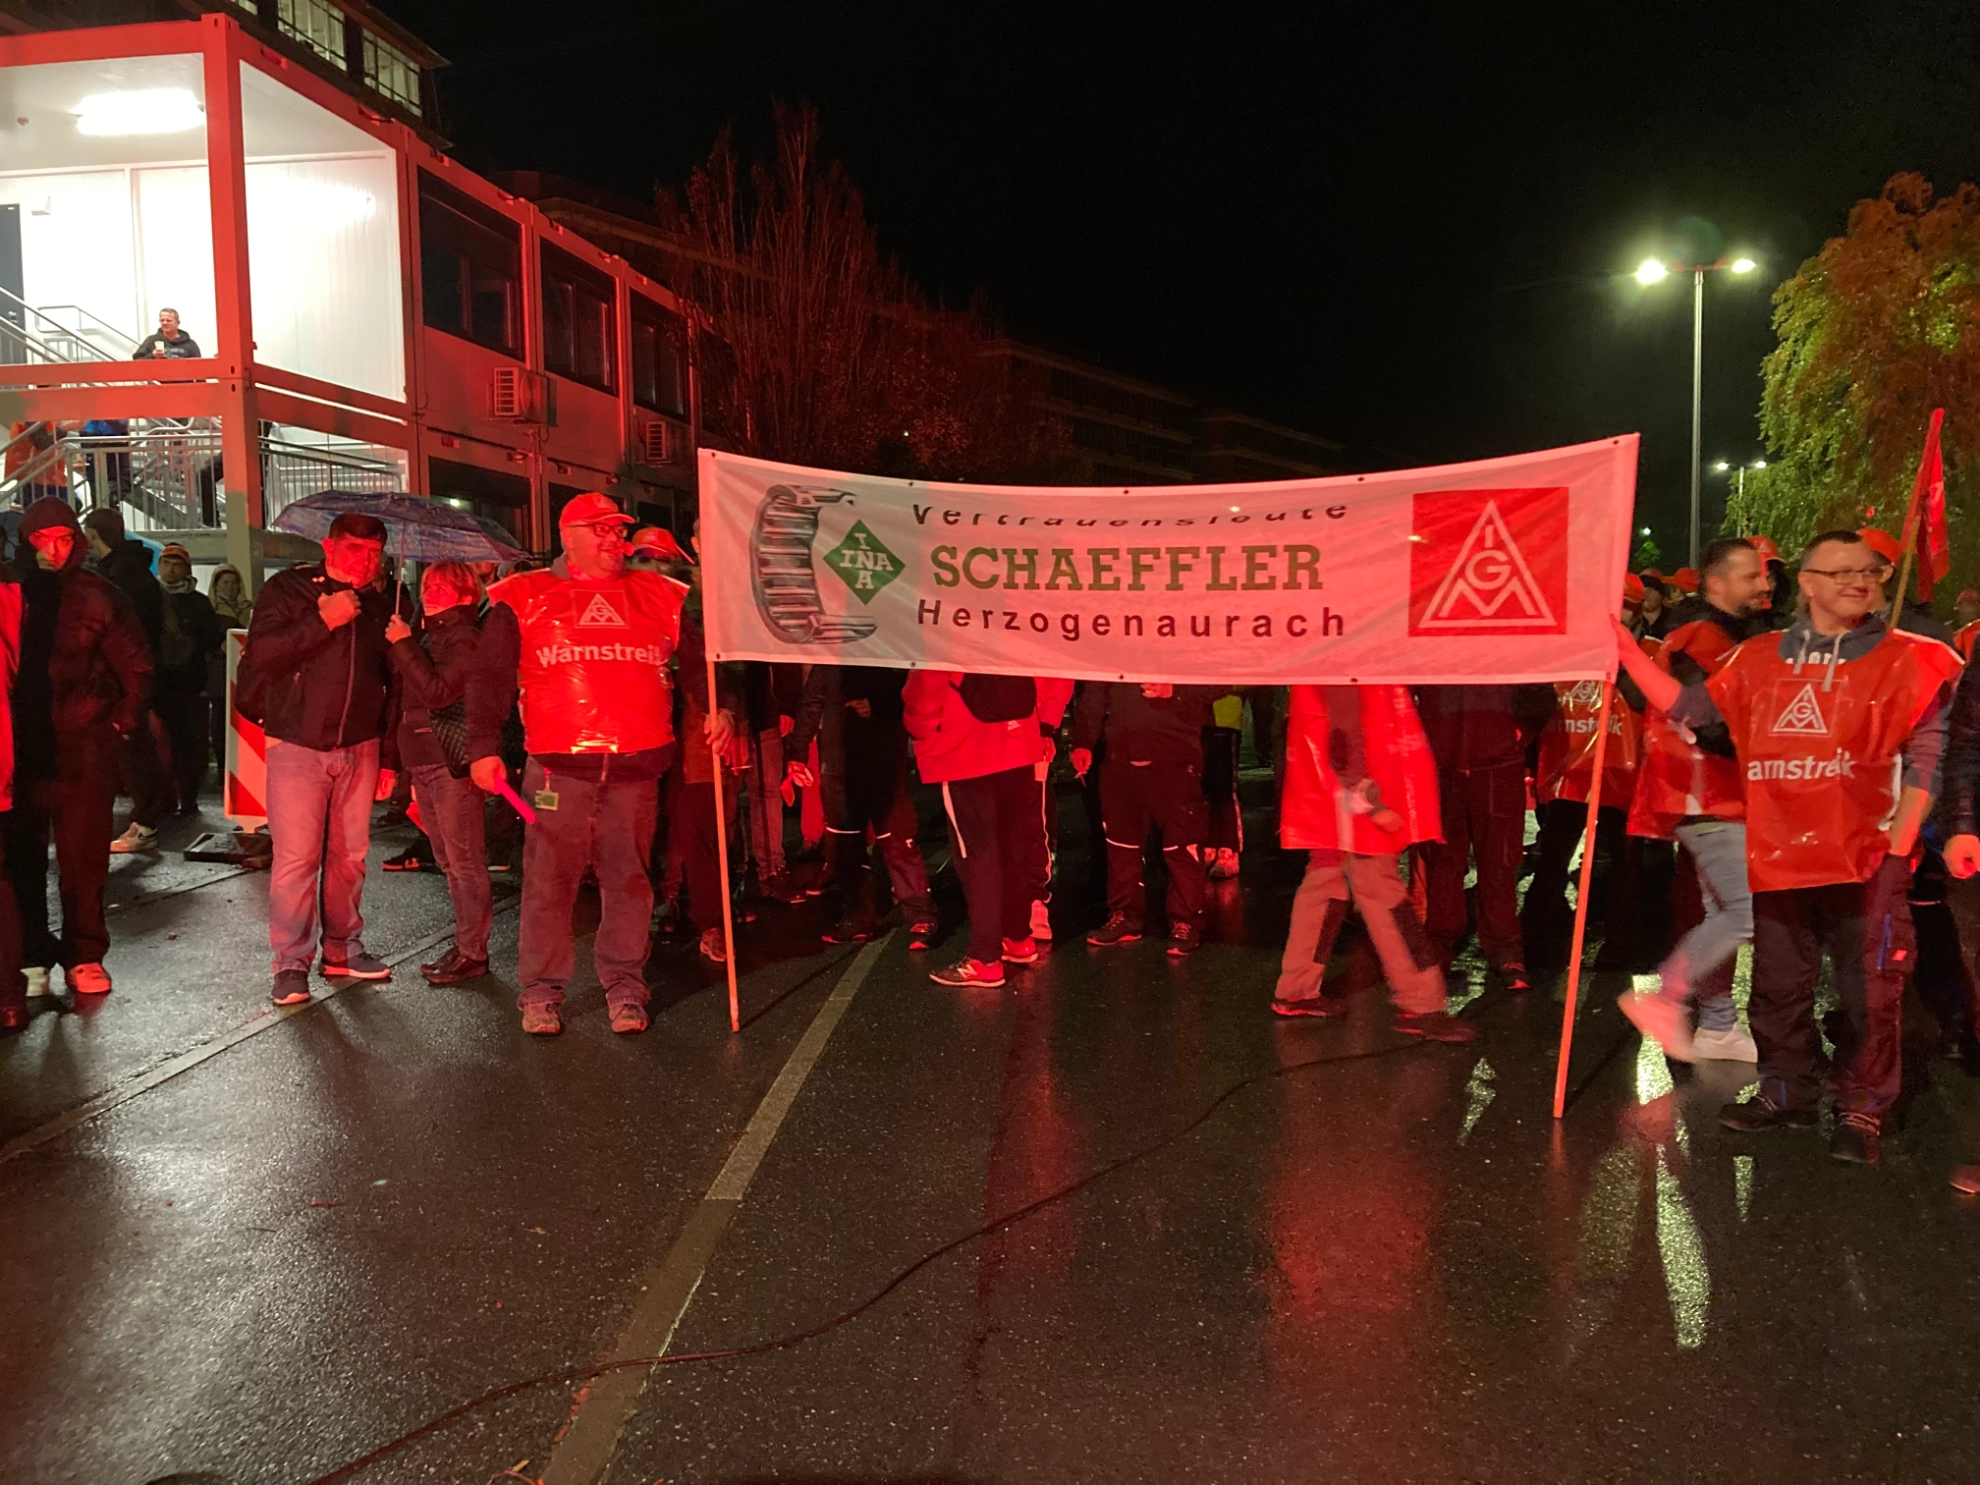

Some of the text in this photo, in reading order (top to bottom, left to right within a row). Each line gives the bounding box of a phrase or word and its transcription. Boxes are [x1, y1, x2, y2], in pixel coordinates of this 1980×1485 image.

[912, 504, 1347, 527] Vertrauensleute
[839, 549, 894, 571] INA
[930, 544, 1324, 591] SCHAEFFLER
[917, 599, 1344, 641] Herzogenaurach
